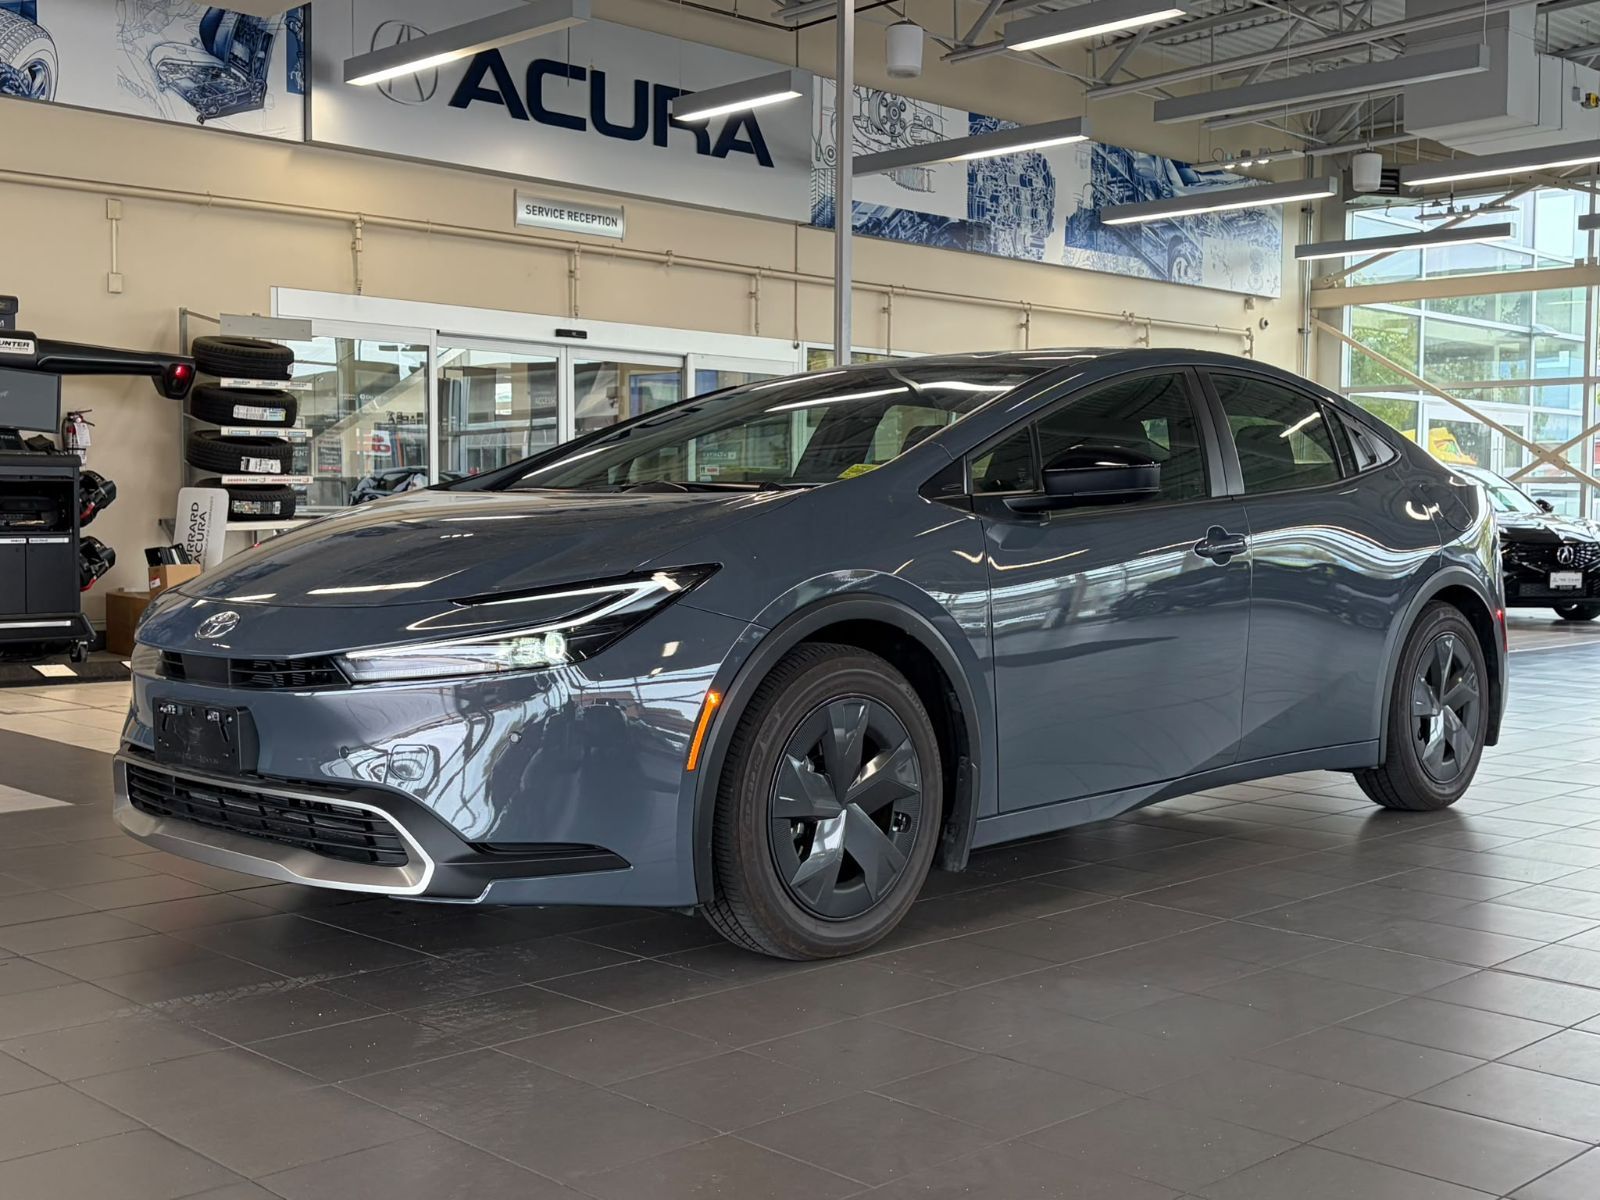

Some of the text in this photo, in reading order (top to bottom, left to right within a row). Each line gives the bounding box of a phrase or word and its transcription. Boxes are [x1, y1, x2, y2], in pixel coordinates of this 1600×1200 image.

[448, 48, 774, 168] ACURA
[525, 204, 618, 227] SERVICE RECEPTION
[0, 340, 30, 348] UNTER
[186, 502, 200, 562] URRARD
[194, 511, 207, 564] ACURA
